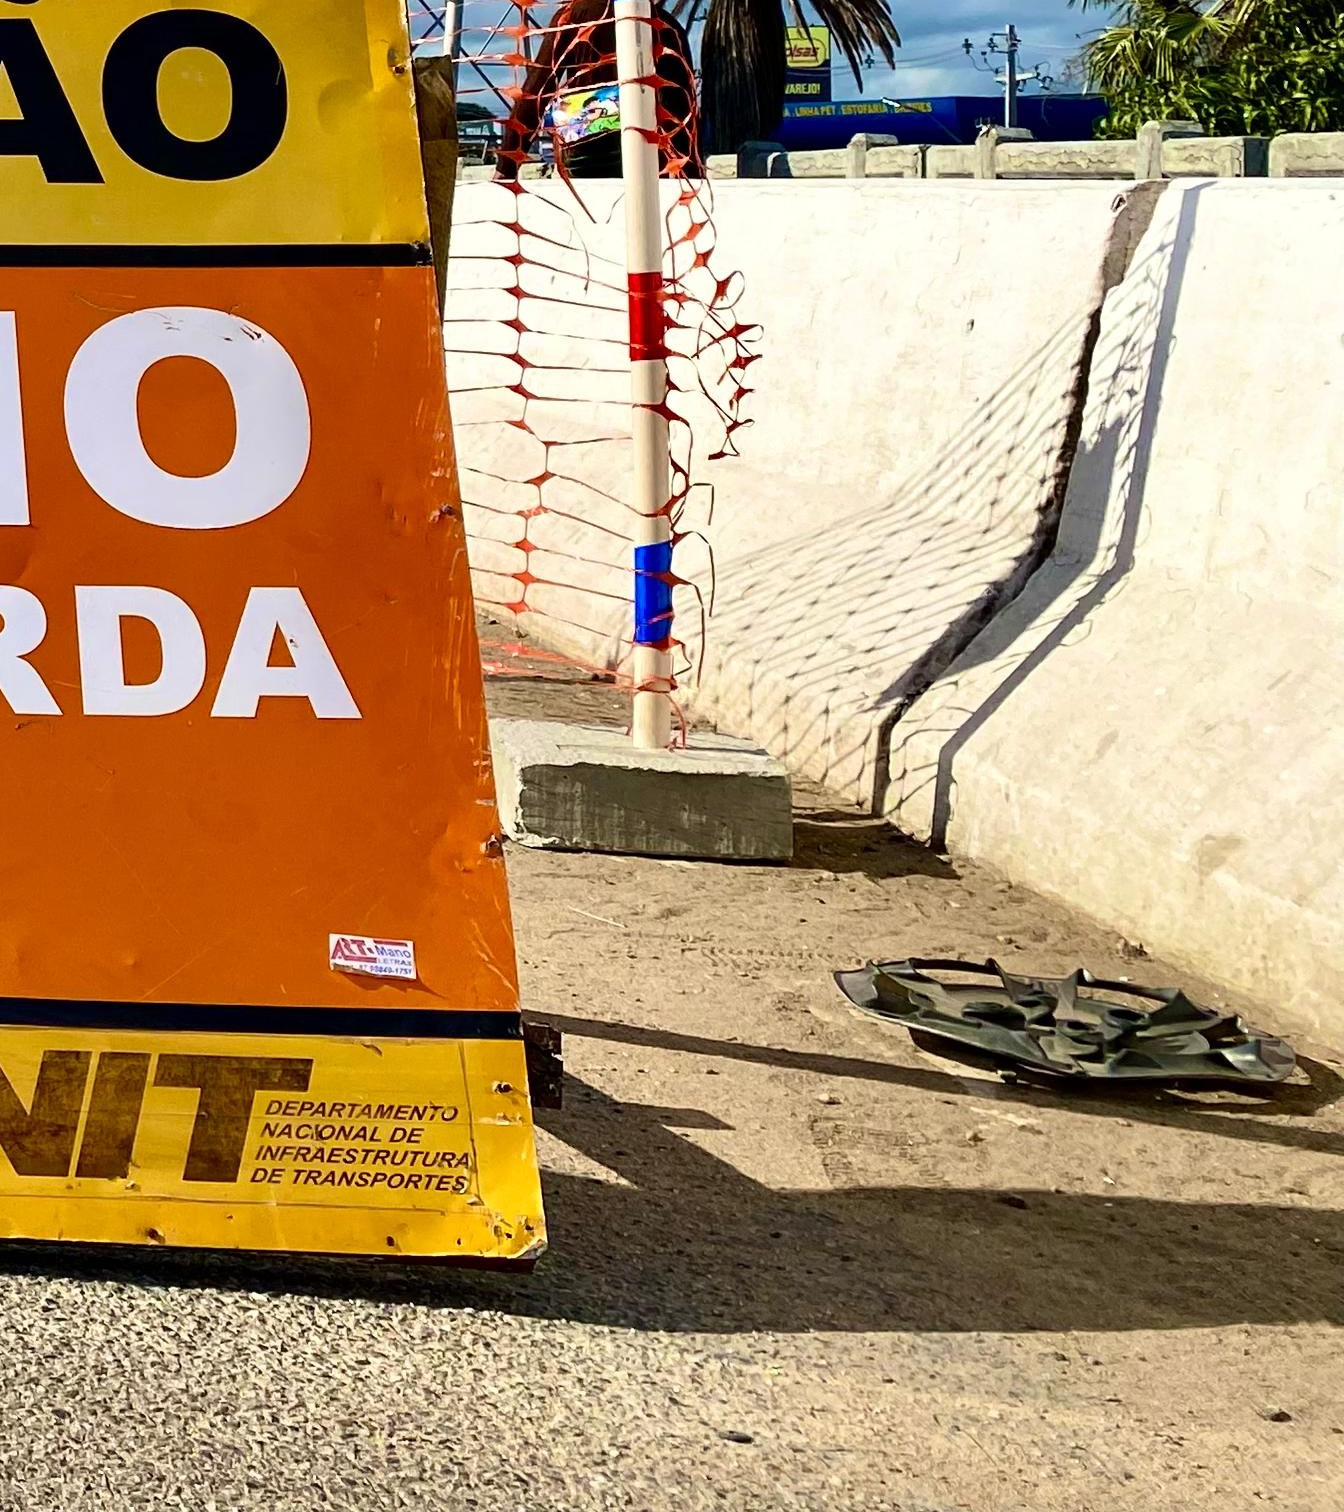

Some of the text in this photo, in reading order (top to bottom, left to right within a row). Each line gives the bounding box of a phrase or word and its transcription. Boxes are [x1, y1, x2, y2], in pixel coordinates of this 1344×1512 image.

[375, 945, 411, 959] Mano
[265, 1099, 459, 1122] DEPARTAMENTO
[261, 1122, 425, 1145] NACIONAL DE
[255, 1144, 471, 1169] INFRAESTRUTURA
[250, 1167, 470, 1194] DE TRANSPORTES
